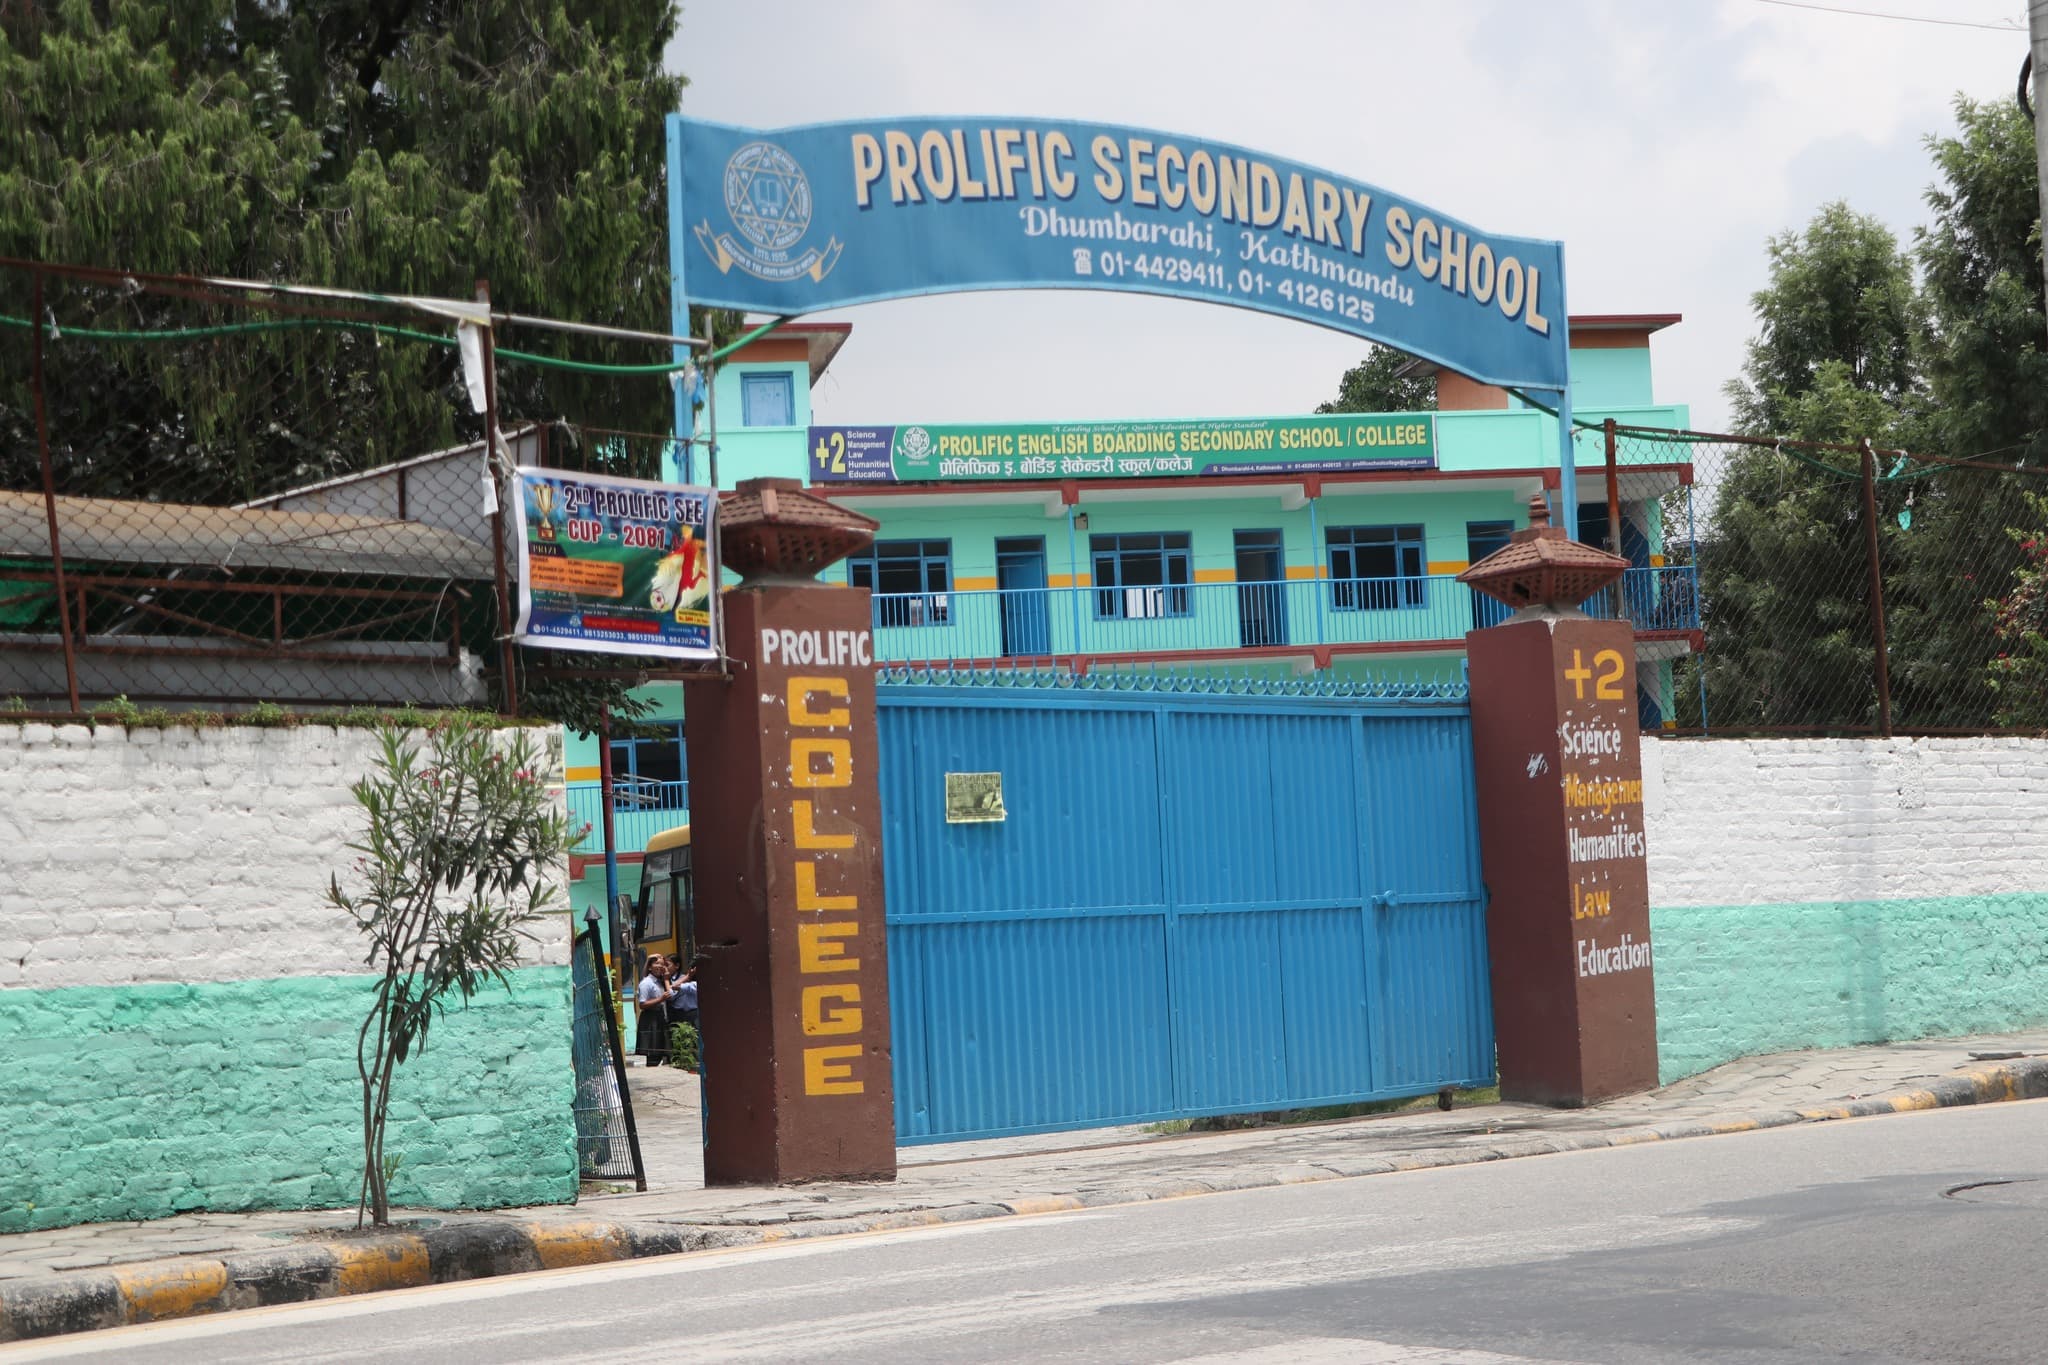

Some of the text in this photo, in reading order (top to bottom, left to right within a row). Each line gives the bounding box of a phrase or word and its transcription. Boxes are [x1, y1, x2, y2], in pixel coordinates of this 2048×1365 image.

[851, 128, 1549, 336] PROLIFIC SECONDARY SCHOOL
[1019, 205, 1415, 307] Dhumbarahi, Kathmandu
[815, 432, 846, 473] +2
[847, 430, 877, 439] Science
[847, 440, 886, 450] Management
[939, 434, 1014, 457] PROLIFIC
[1018, 433, 1088, 455] ENGLISH
[1092, 431, 1177, 454] BOARDING
[1180, 429, 1275, 452] SECONDARY
[1279, 427, 1344, 449] SCHOOL
[1355, 424, 1427, 446] COLLEGE
[848, 451, 864, 459] Law
[848, 460, 890, 469] Humanities
[848, 470, 887, 479] Education
[595, 489, 671, 521] PROLIFIC
[674, 497, 704, 526] SEE
[568, 518, 602, 543] CUP
[623, 524, 666, 550] 2081
[761, 628, 871, 667] PROLIFIC
[1564, 648, 1625, 700] +2
[1562, 721, 1621, 756] Science
[1568, 824, 1645, 863] Humanities
[787, 676, 865, 1096] COLLEGE
[1574, 883, 1611, 920] Law
[1578, 933, 1651, 977] Education
